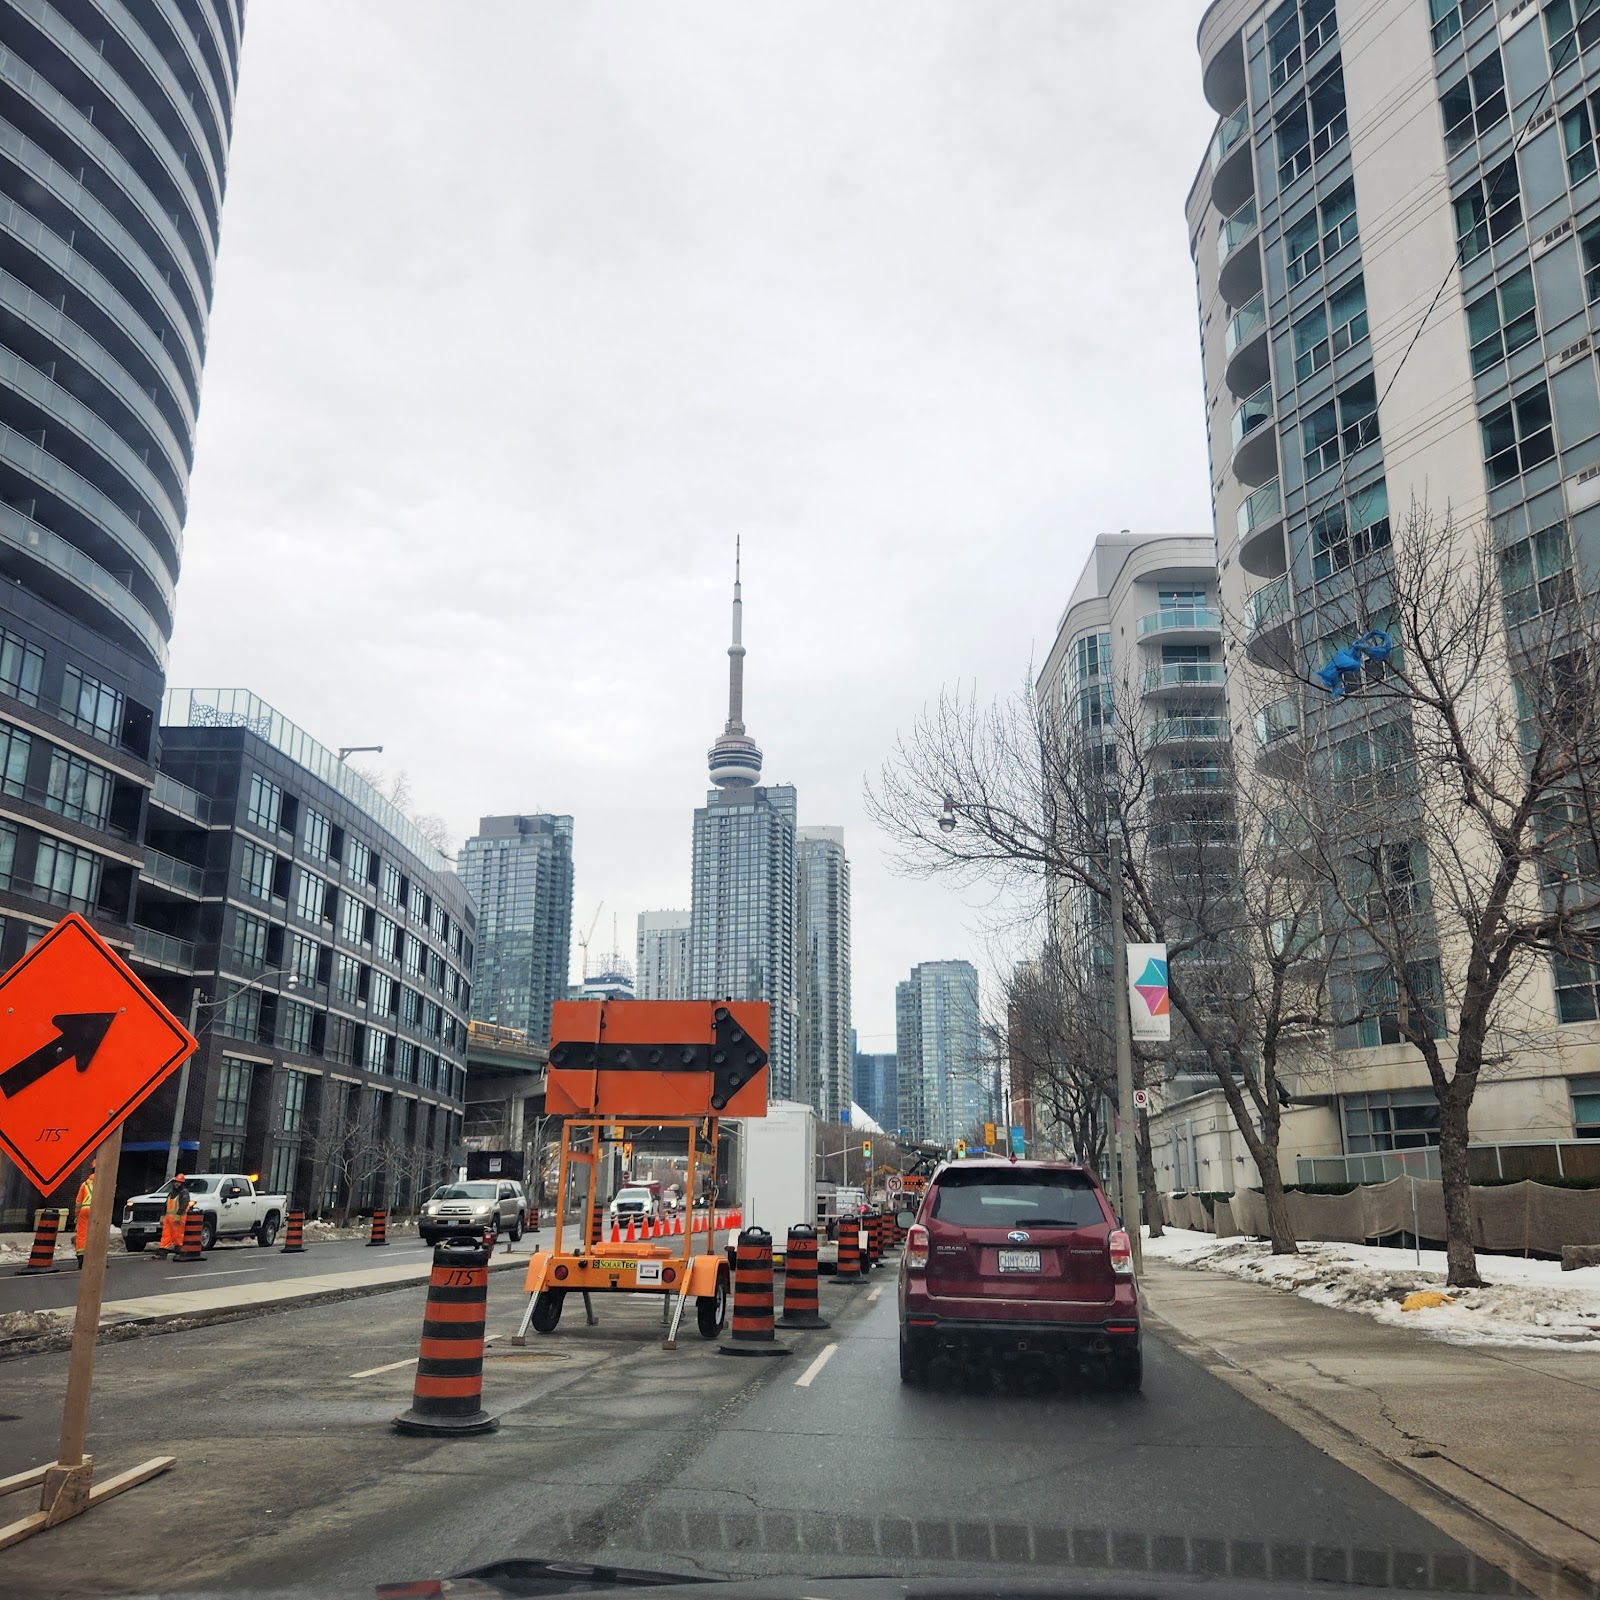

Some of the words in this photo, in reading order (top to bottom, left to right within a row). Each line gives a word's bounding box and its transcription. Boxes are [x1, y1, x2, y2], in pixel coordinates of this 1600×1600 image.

[35, 1128, 69, 1142] JTS
[792, 1241, 812, 1250] JTS
[443, 1270, 482, 1286] JTS
